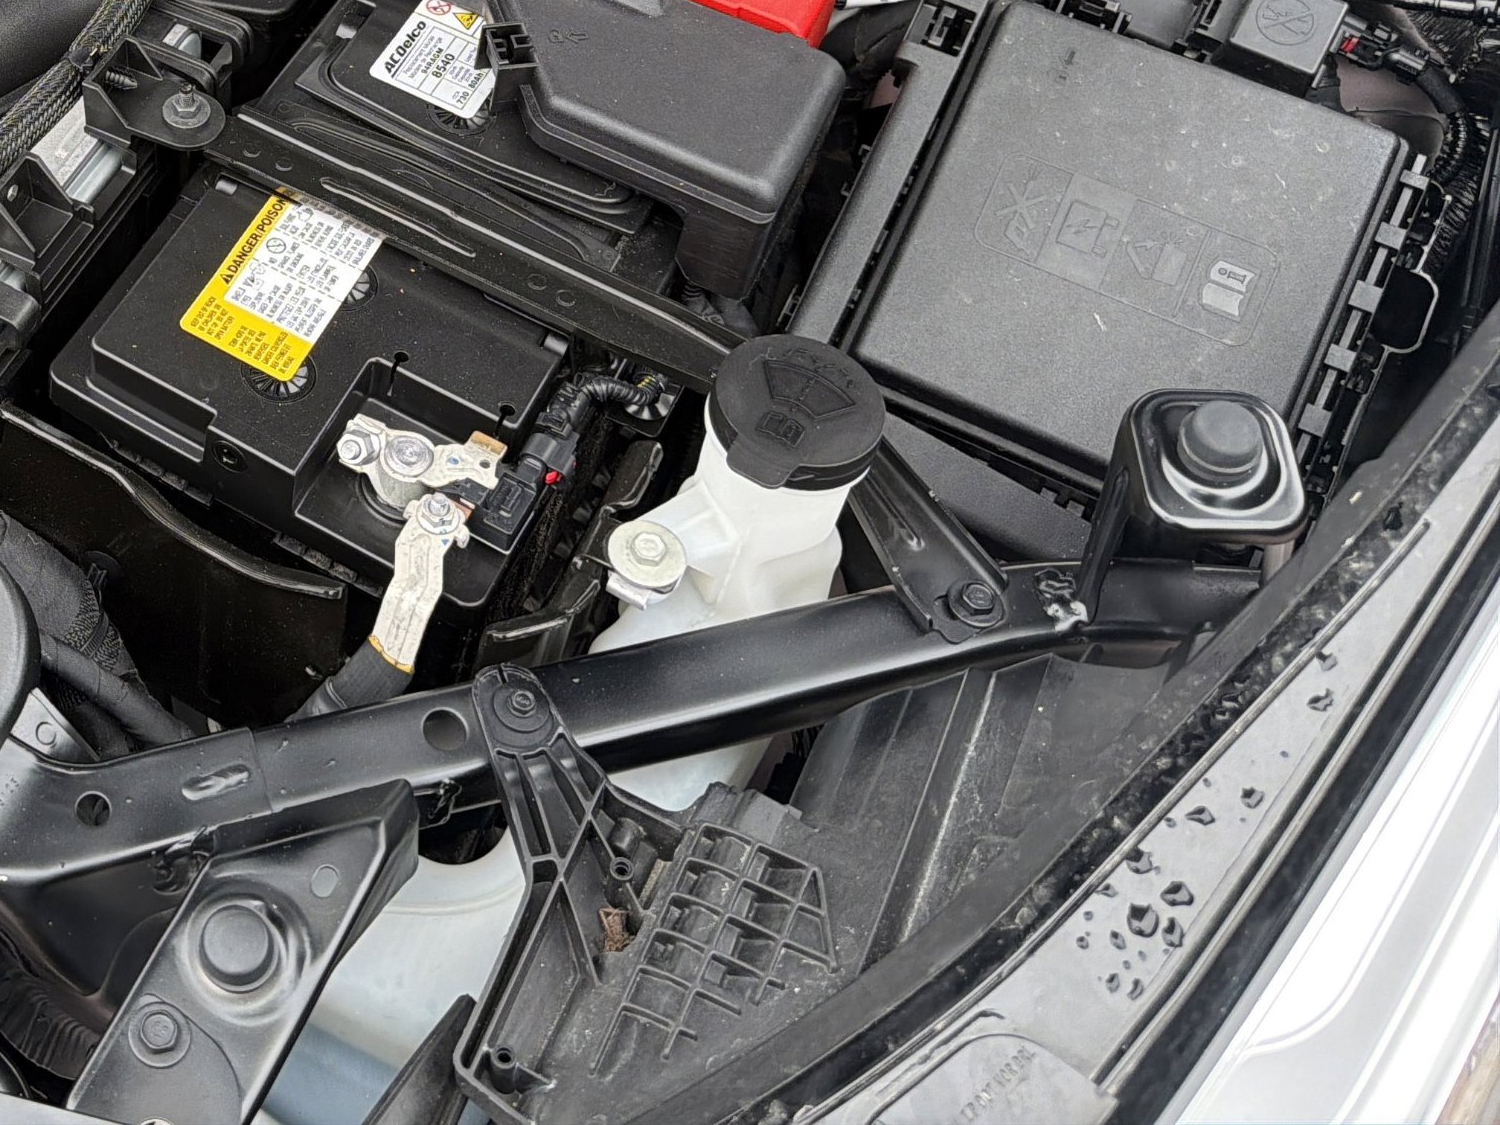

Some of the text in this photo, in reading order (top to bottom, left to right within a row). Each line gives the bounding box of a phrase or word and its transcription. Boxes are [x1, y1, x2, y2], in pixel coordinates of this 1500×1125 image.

[384, 21, 426, 74] ACDelco
[421, 47, 443, 75] 94RAGM
[431, 53, 455, 79] 8540
[456, 91, 469, 105] 730
